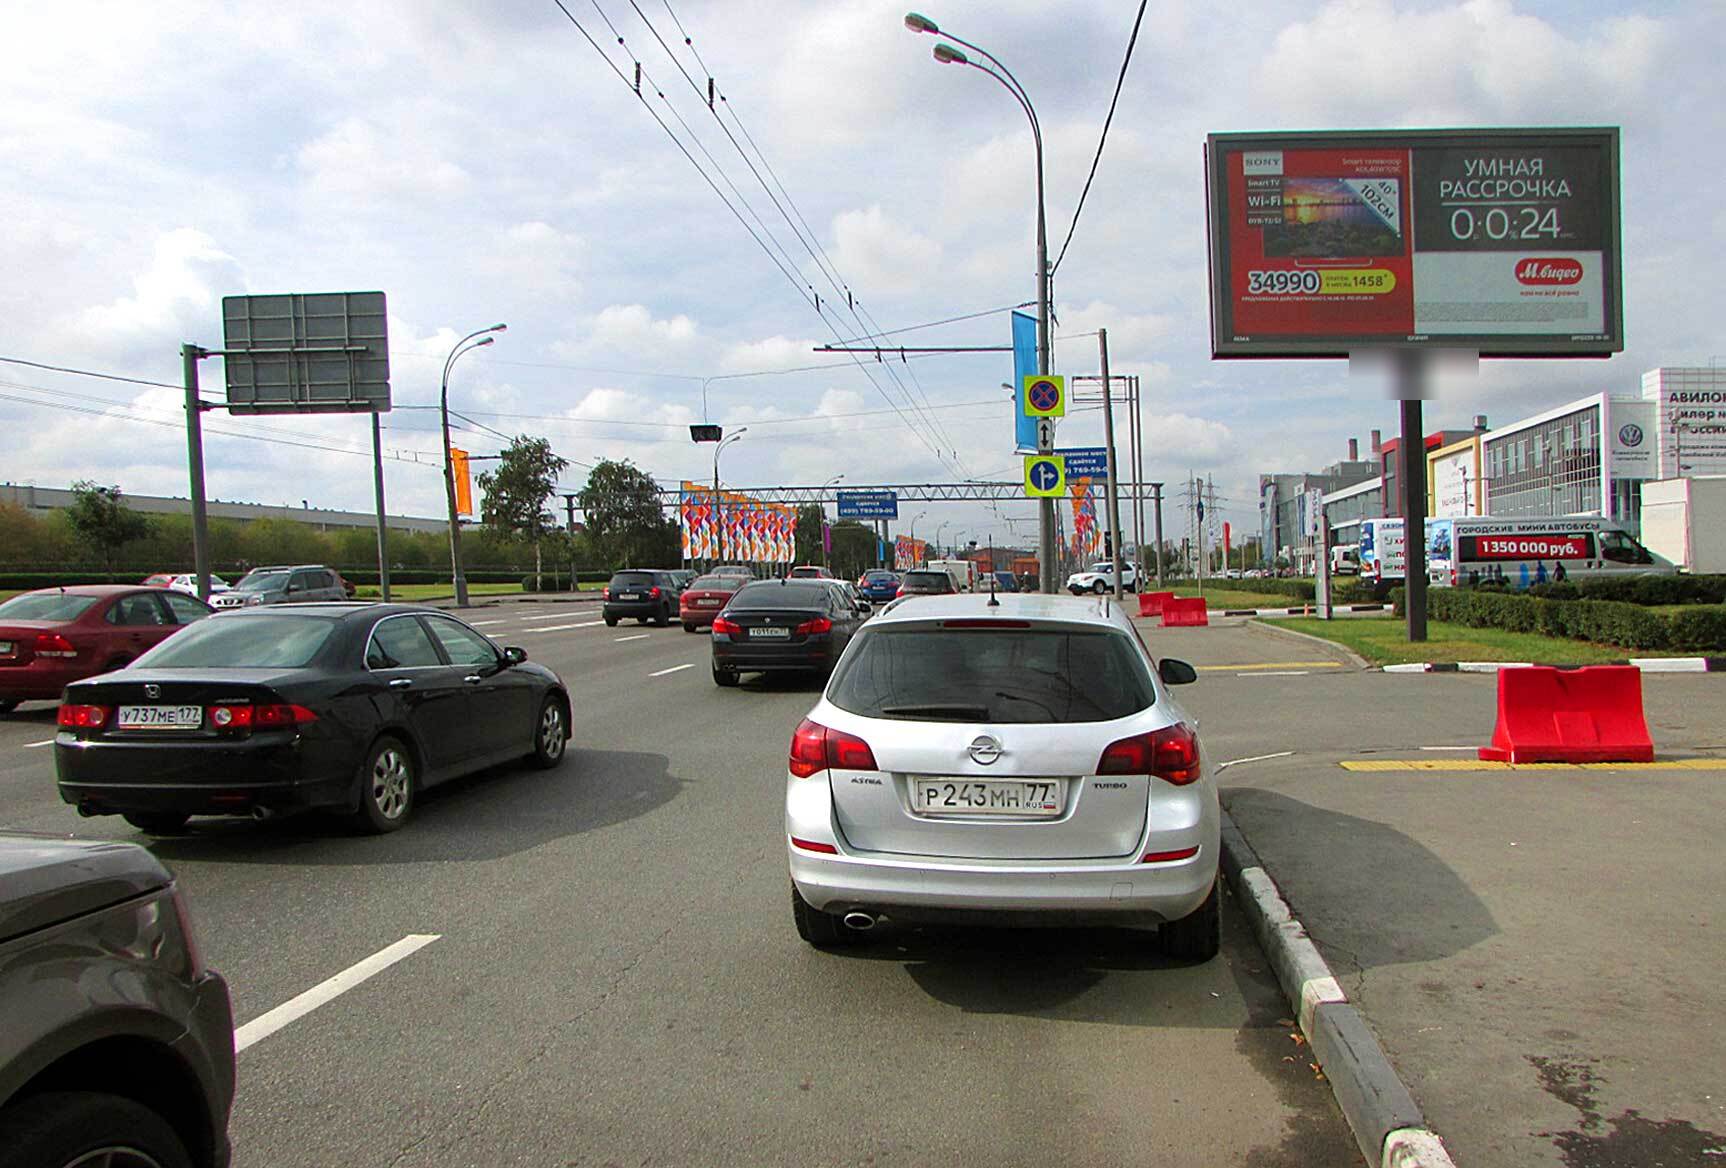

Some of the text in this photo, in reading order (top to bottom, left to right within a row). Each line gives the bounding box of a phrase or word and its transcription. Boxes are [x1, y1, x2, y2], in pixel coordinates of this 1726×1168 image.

[1464, 158, 1543, 177] УМНАЯ
[1440, 179, 1572, 199] РАССРОЧКА
[1248, 196, 1281, 207] Wi-Fi
[1249, 271, 1318, 293] 34990
[1457, 525, 1514, 534] ГОРОДСКИЕ
[1550, 543, 1578, 556] руб.
[122, 707, 200, 723] У737МЕ 177
[1026, 784, 1050, 802] 77
